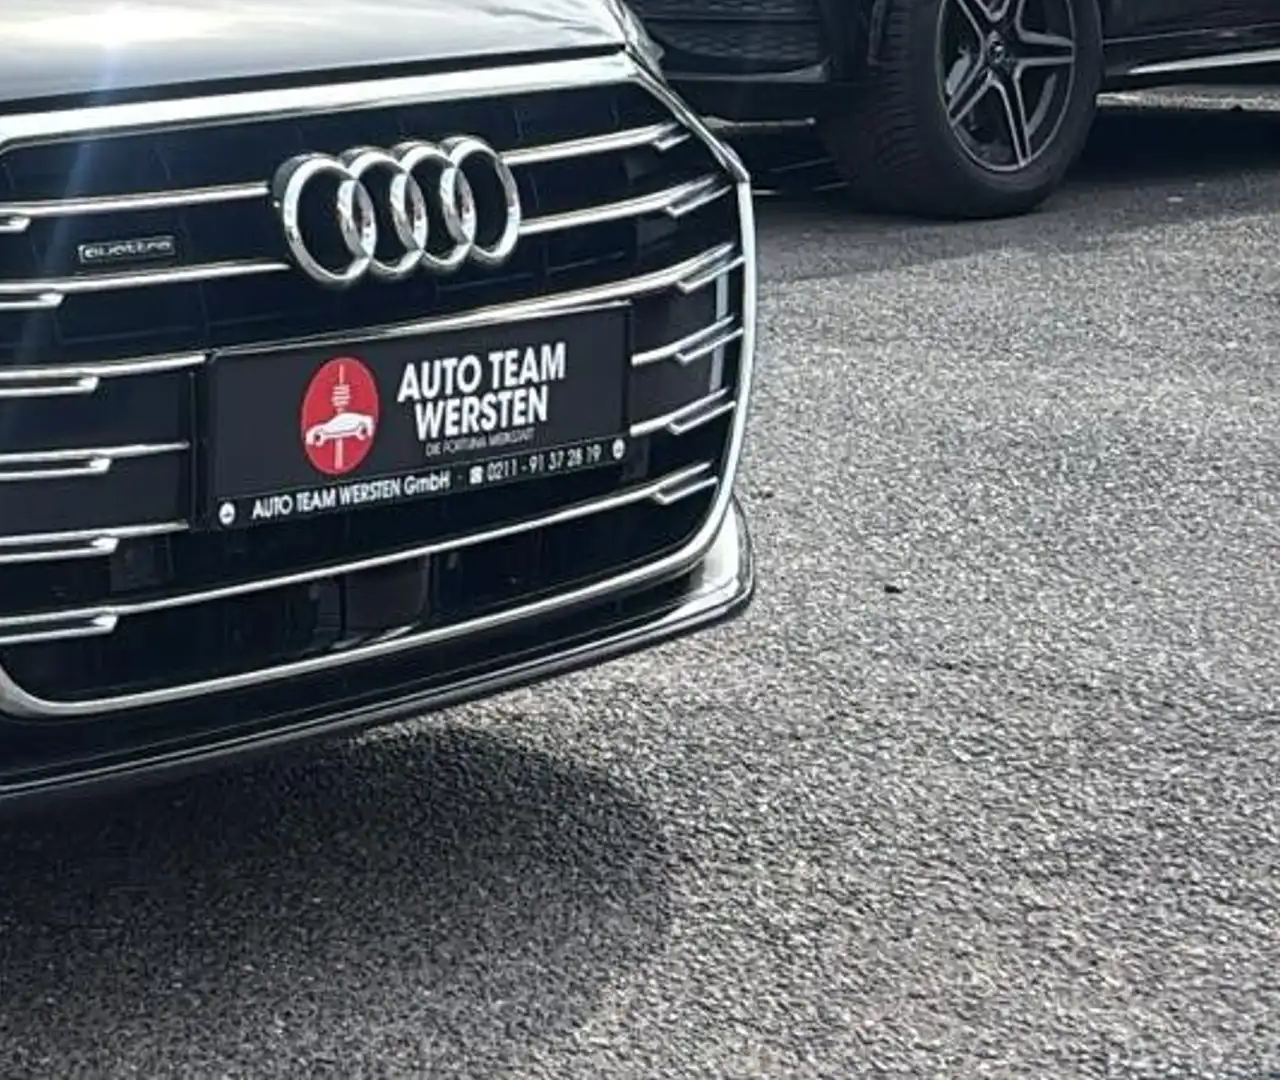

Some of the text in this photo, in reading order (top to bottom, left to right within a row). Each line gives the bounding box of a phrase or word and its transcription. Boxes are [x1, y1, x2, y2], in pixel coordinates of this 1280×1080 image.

[397, 341, 567, 403] AUTO TEAM
[413, 385, 550, 441] WERSTEN
[251, 496, 294, 520] AUTO
[296, 488, 337, 513] TEAM
[340, 477, 402, 506] WERSTEN
[403, 470, 452, 495] GmbH
[487, 458, 517, 482] 0211
[529, 454, 544, 474] 91
[548, 450, 564, 470] 37
[586, 443, 602, 462] 19
